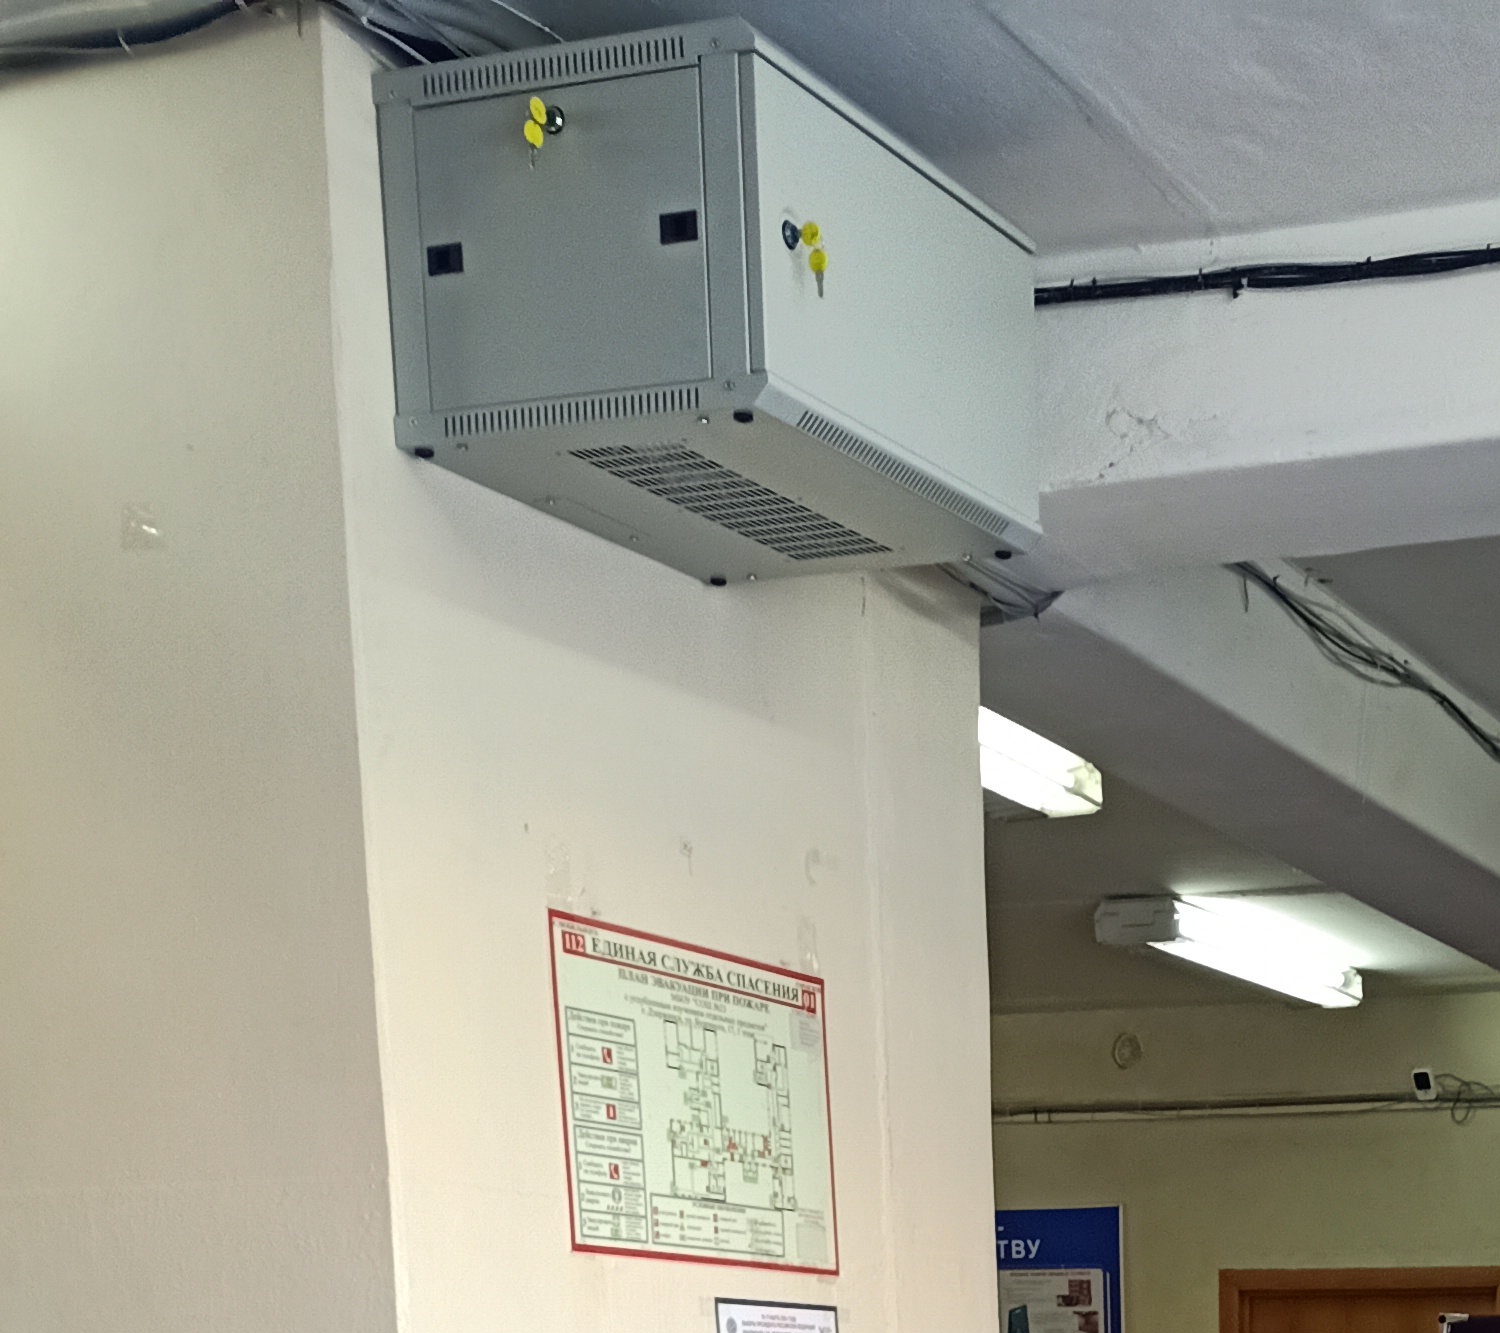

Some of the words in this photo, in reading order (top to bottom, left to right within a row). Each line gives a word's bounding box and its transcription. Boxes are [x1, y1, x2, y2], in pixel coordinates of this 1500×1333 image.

[564, 933, 584, 953] 112
[591, 937, 657, 967] ЕДИНАЯ
[661, 954, 723, 983] СЛУЖБА
[727, 971, 799, 1003] СПАСЕНИЯ
